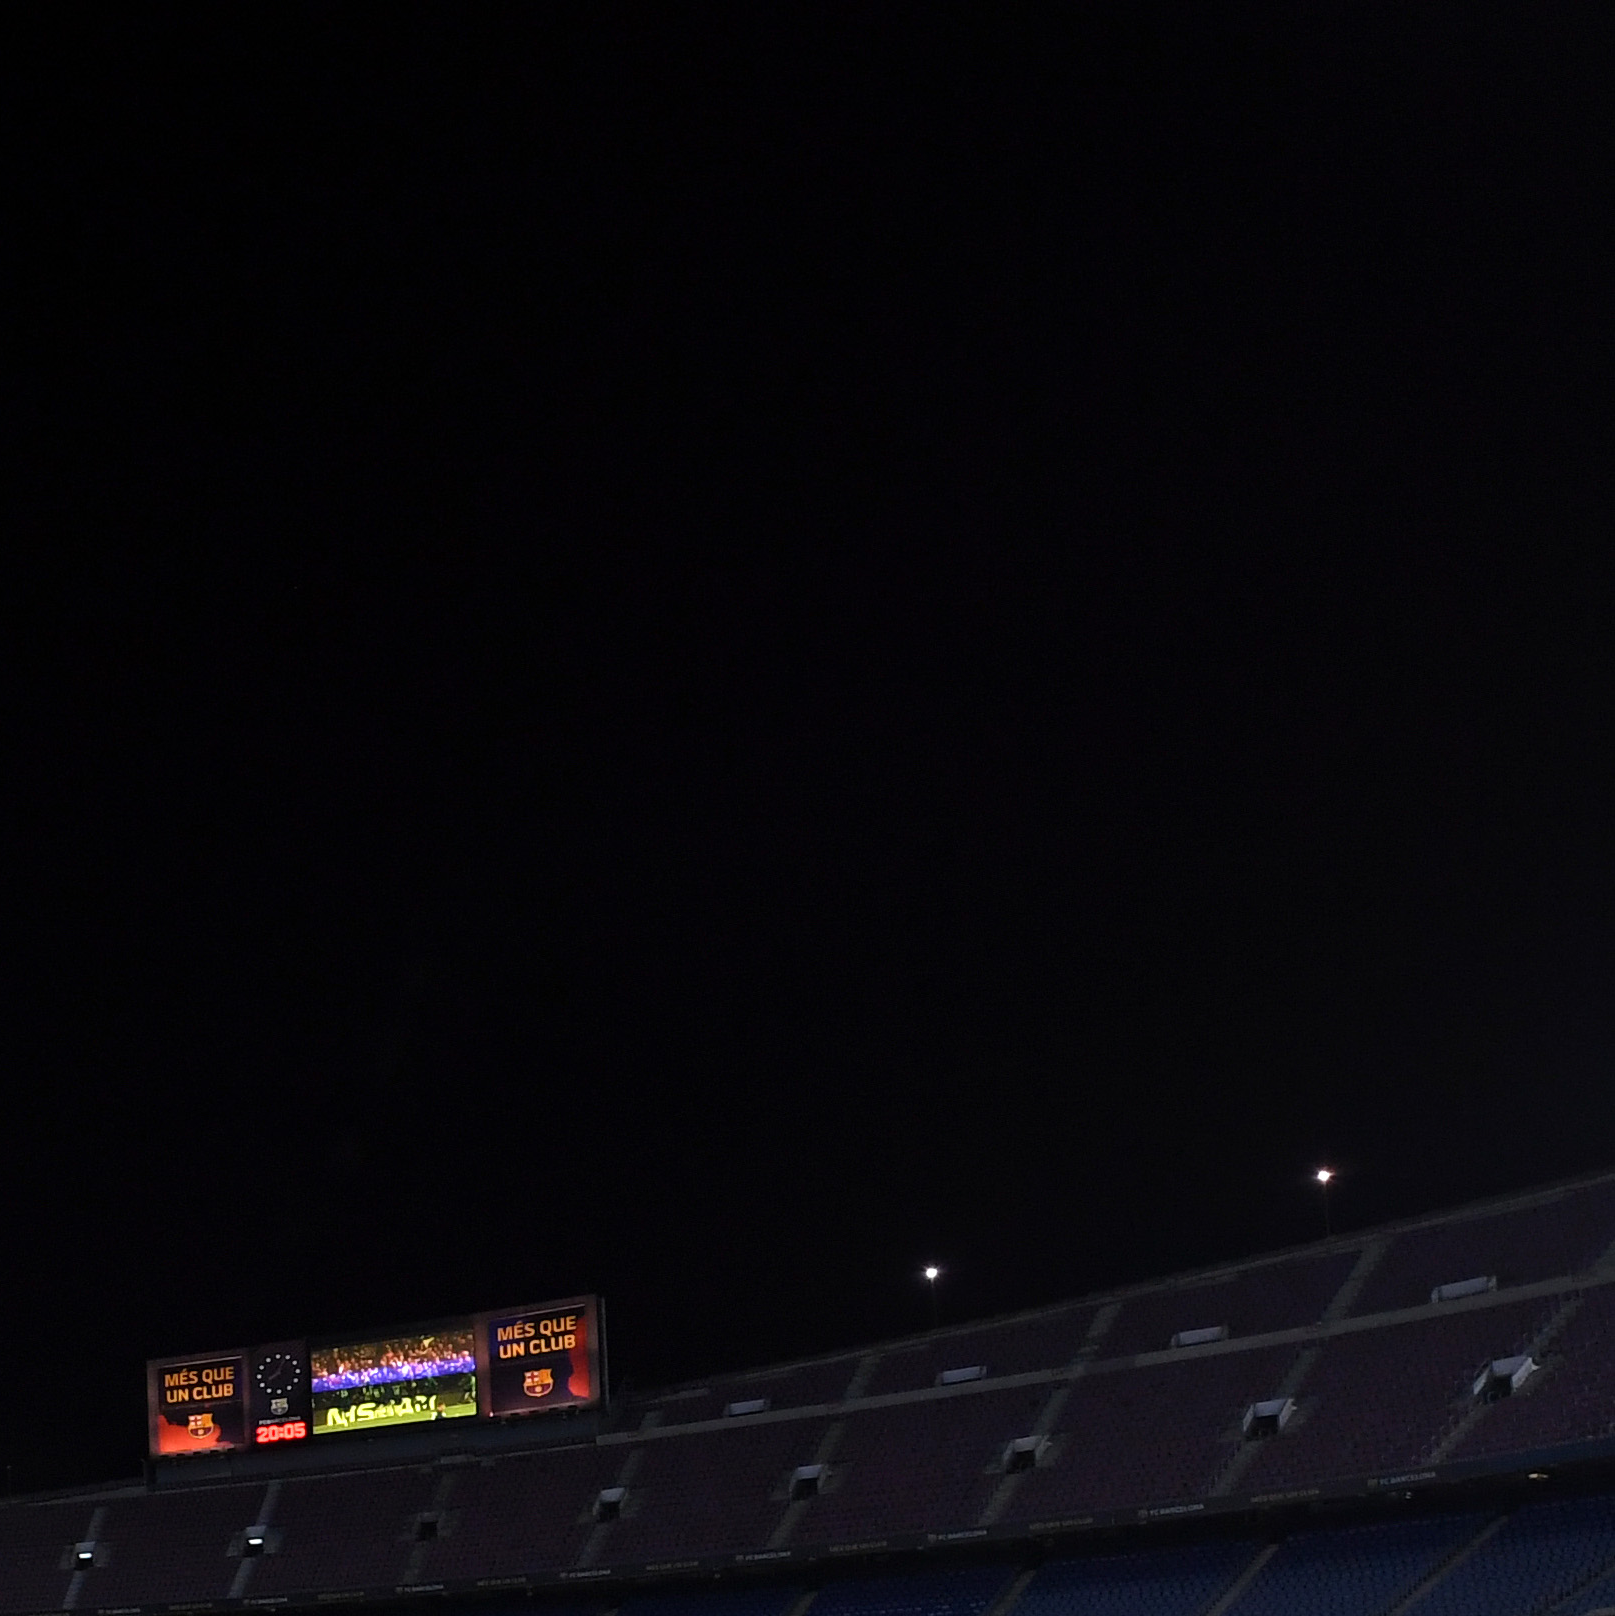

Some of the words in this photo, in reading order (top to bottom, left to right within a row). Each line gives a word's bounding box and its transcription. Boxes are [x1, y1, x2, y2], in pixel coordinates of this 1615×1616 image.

[497, 1321, 536, 1341] MÉS
[539, 1315, 577, 1336] QUE
[499, 1342, 525, 1359] UN
[529, 1334, 576, 1354] CLUB
[164, 1368, 199, 1387] MÉS
[202, 1366, 235, 1384] QUE
[166, 1388, 189, 1403] UN
[192, 1383, 234, 1400] CLUB
[257, 1422, 306, 1443] 20:05
